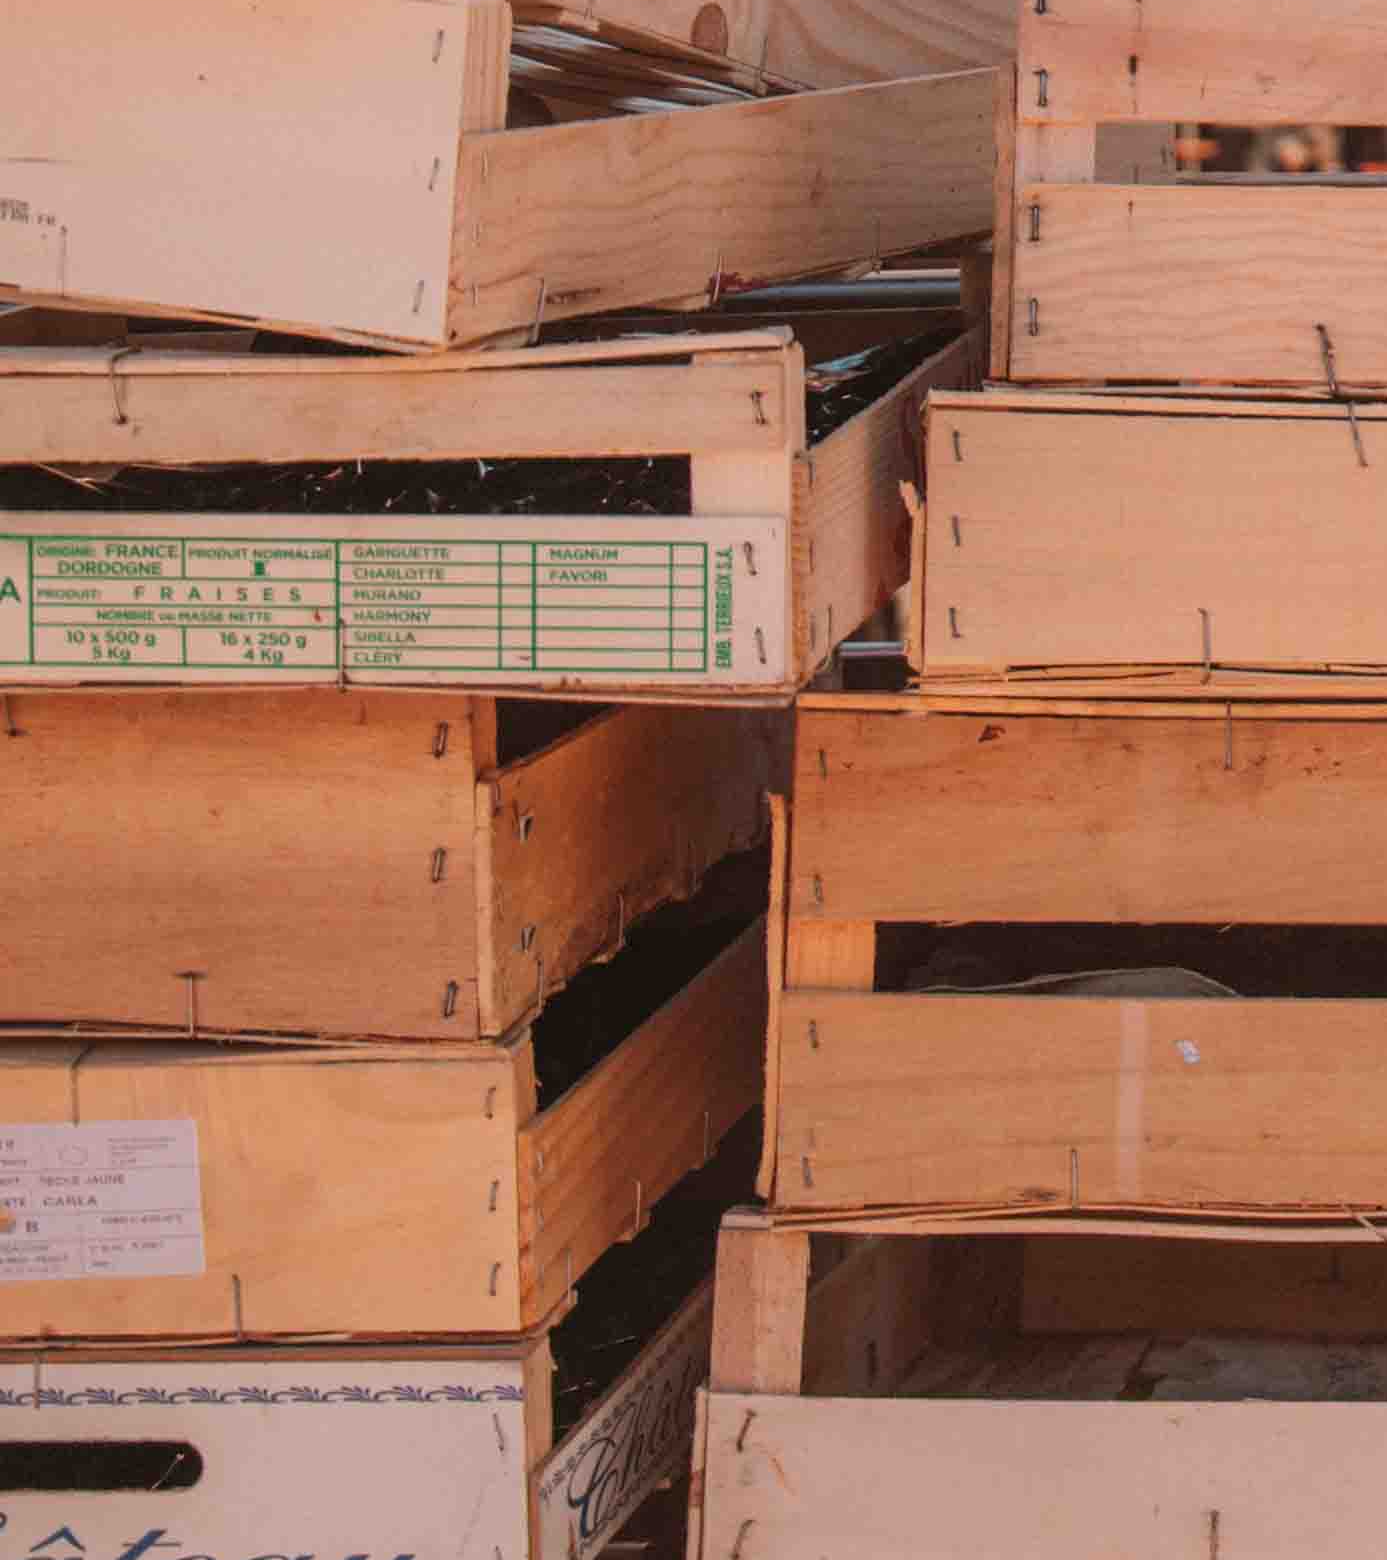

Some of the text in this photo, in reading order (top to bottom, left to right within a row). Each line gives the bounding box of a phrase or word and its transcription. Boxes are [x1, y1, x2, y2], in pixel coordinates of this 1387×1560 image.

[105, 543, 179, 560] FRANCE
[188, 548, 248, 560] PRODUIT
[352, 547, 452, 560] GARIGUETTE
[549, 547, 619, 561] MAGNUM
[57, 560, 163, 575] DORDOGNE
[352, 567, 446, 581] CHARLOTTE
[549, 569, 609, 582] FAVORI
[352, 589, 422, 601] MURANO
[228, 611, 273, 623] NETTE
[352, 610, 432, 623] HARMONY
[65, 631, 85, 644] 10
[104, 630, 140, 645] 500
[220, 632, 239, 647] 16
[257, 632, 290, 647] 250
[92, 646, 132, 662] 5 Kg
[243, 648, 284, 664] 4 Kg
